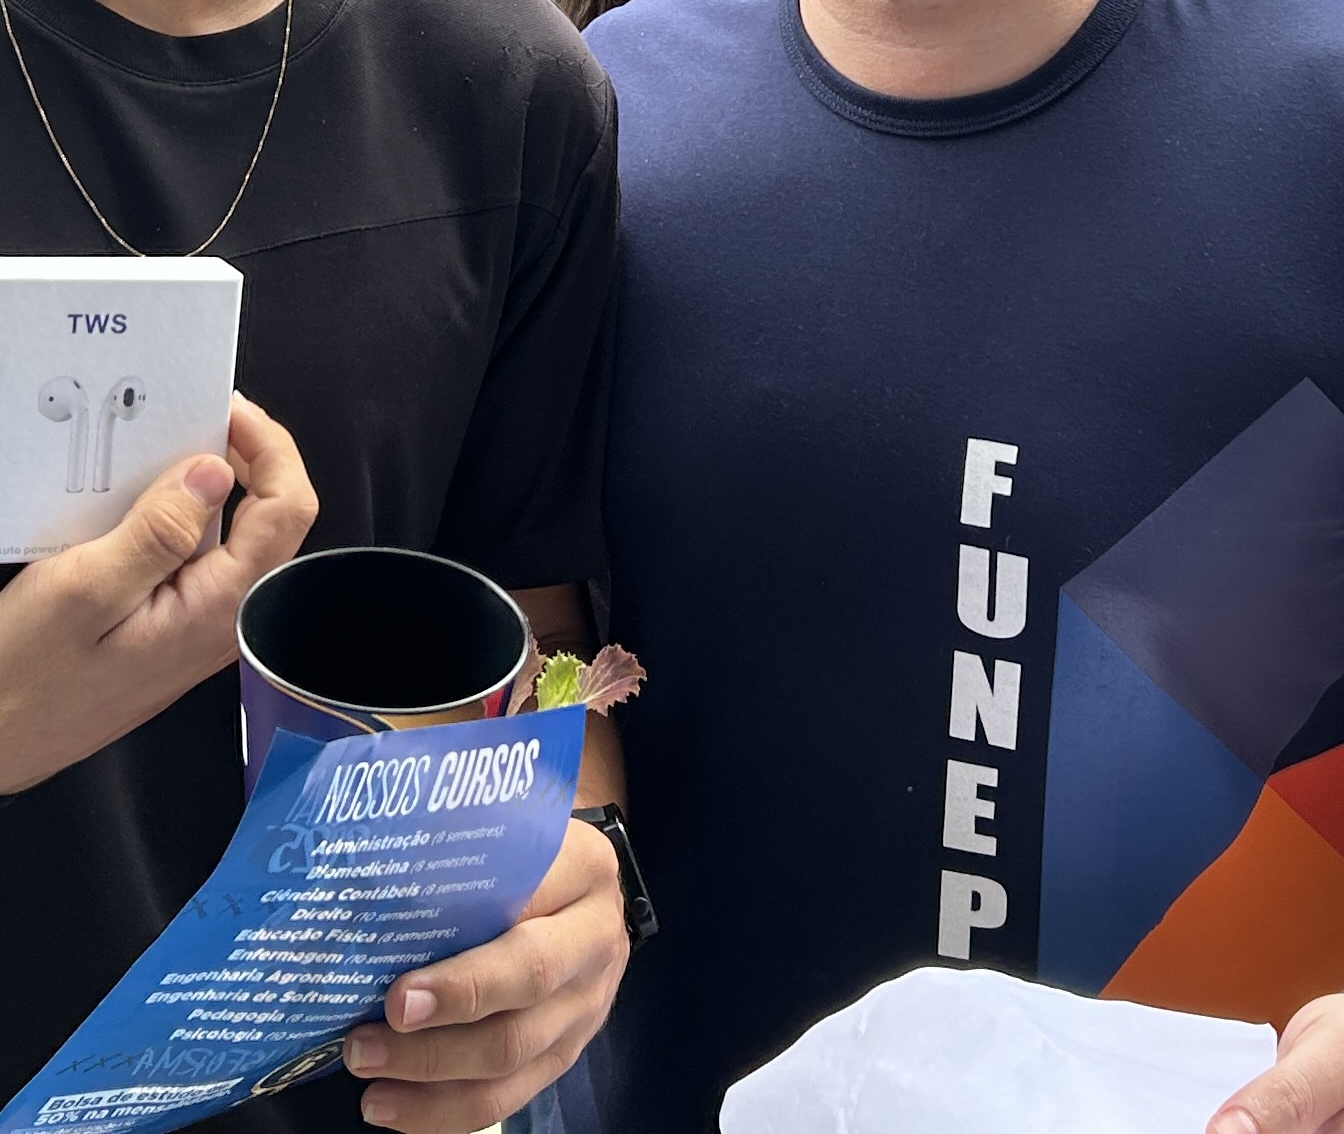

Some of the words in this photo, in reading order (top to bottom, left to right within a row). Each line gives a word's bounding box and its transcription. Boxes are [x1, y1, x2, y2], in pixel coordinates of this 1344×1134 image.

[67, 313, 128, 334] TWS
[314, 754, 432, 825] NOSSOS
[426, 737, 541, 813] CURSOS
[310, 829, 430, 857] Administração
[305, 852, 411, 881] Biomedicina
[260, 887, 335, 904] Ciências
[337, 881, 421, 902] Contábeis
[289, 907, 354, 922] Direito
[234, 926, 323, 946] Educação
[323, 927, 378, 945] Física
[227, 948, 344, 966] Enfermagem
[159, 967, 265, 987] Engenharia
[263, 969, 375, 987] Agronômica
[144, 987, 252, 1005] Engenharia
[251, 990, 278, 1004] de
[278, 990, 359, 1005] Software
[186, 1007, 286, 1026] Pedagogia
[168, 1027, 264, 1044] Psicologia
[46, 1095, 105, 1112] Bolsa
[106, 1090, 135, 1104] de
[33, 1110, 80, 1127] 50%
[82, 1109, 110, 1122] na
